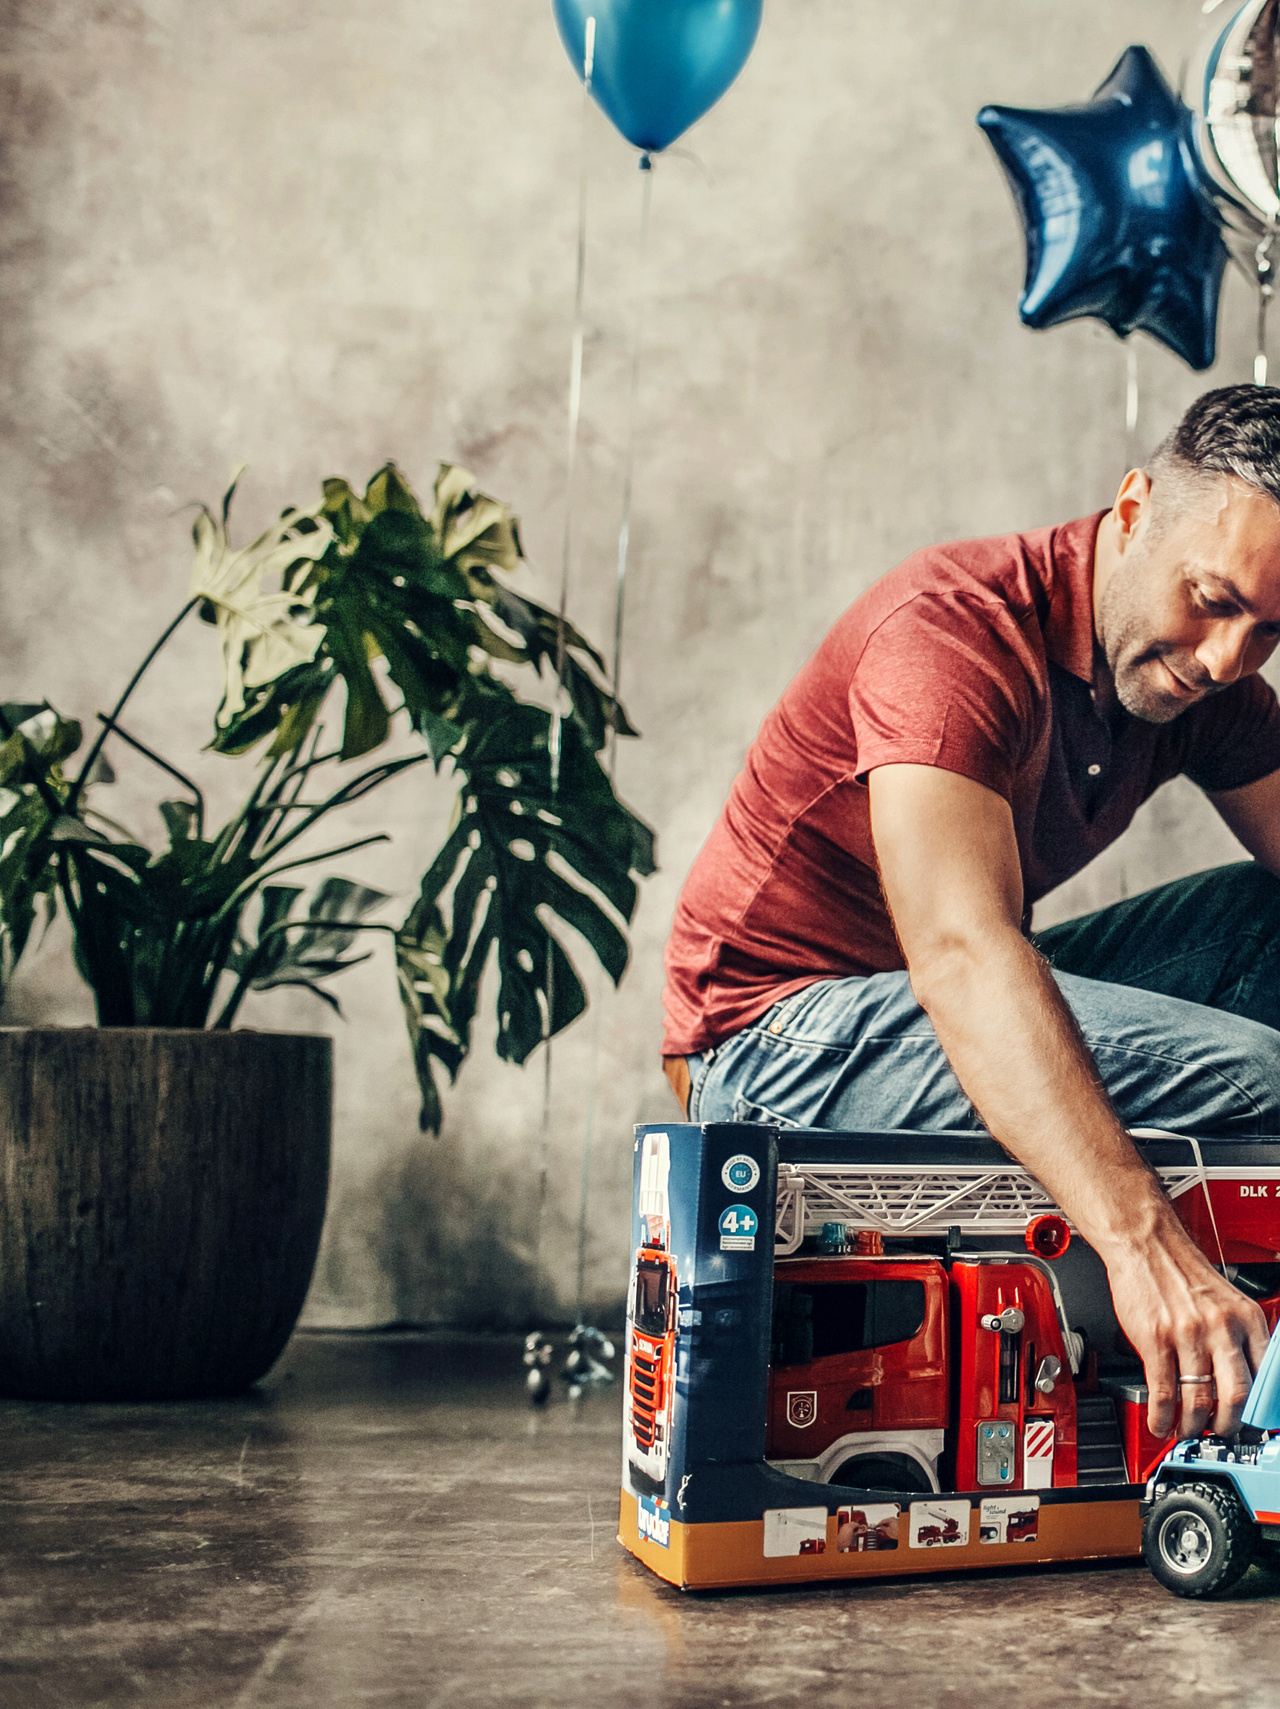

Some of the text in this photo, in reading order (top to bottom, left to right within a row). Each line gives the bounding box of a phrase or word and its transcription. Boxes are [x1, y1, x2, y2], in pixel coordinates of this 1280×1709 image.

[735, 1170, 746, 1178] EU
[727, 1182, 752, 1191] GERMANY
[1240, 1186, 1268, 1197] DLK
[722, 1211, 755, 1233] 4+
